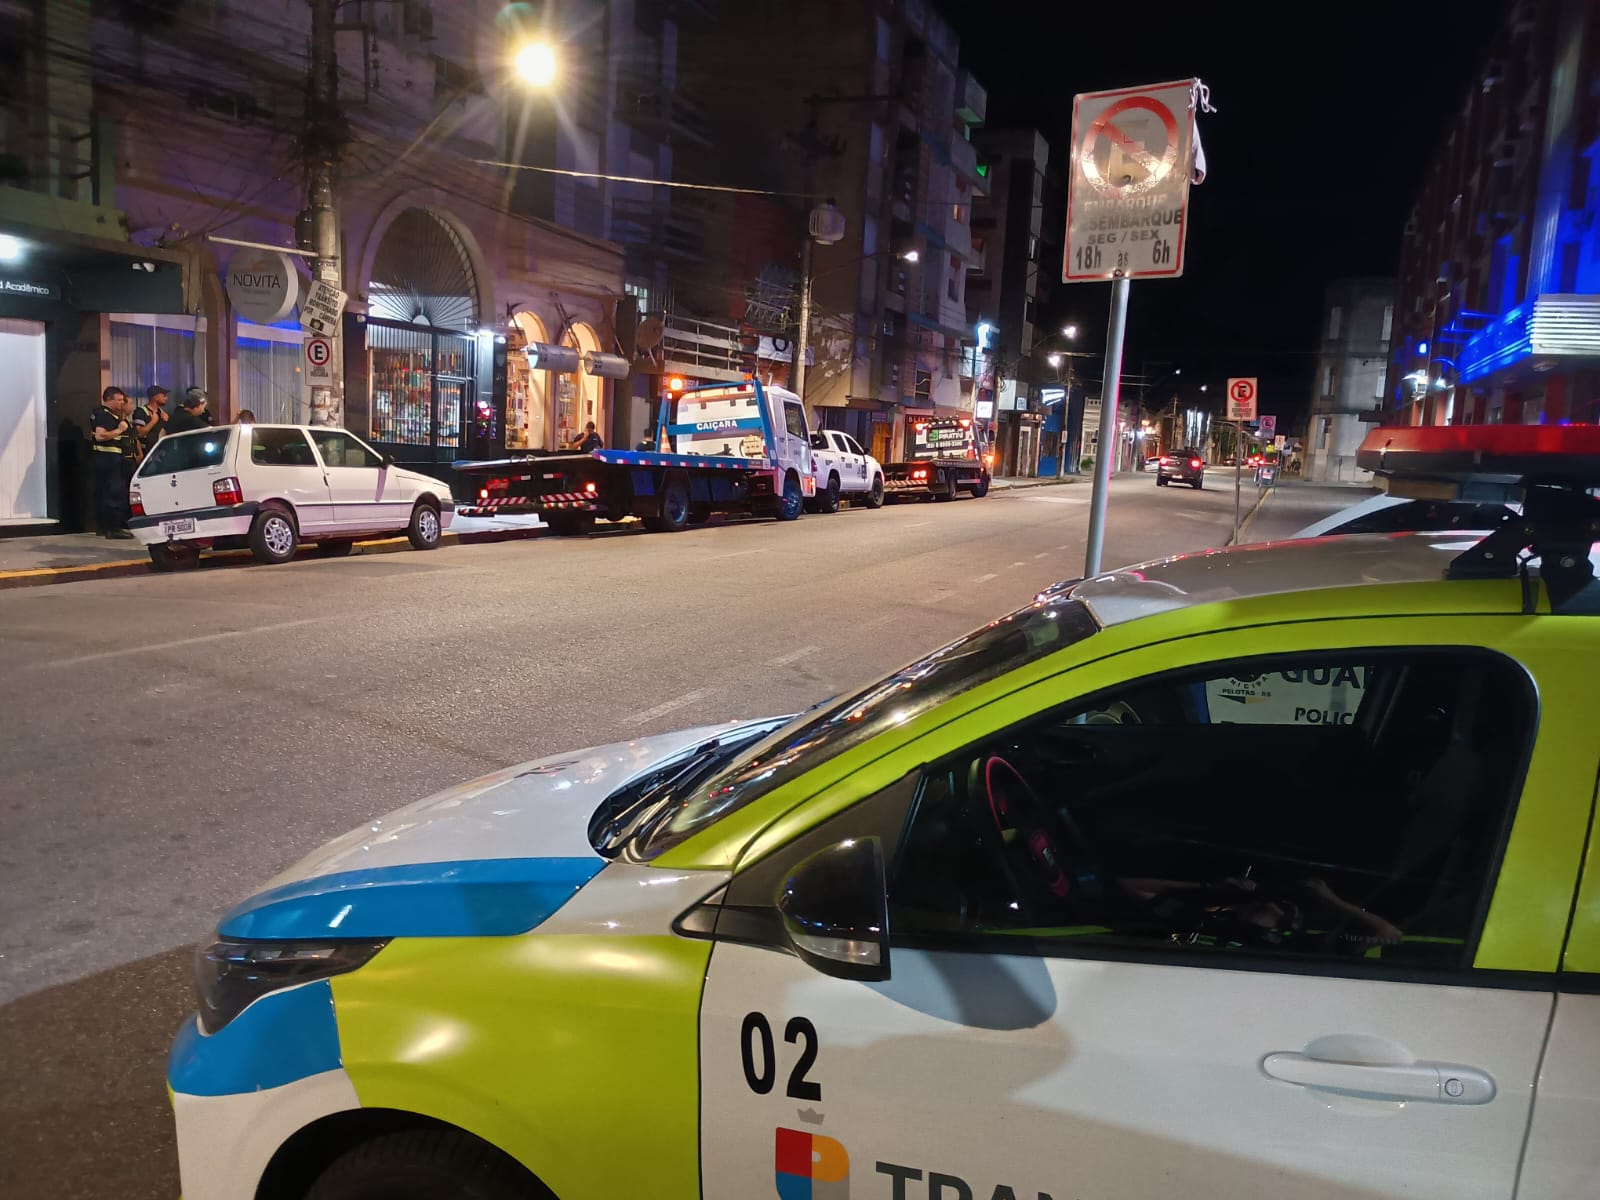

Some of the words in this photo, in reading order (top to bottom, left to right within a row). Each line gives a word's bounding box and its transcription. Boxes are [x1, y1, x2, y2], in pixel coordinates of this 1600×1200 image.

[1087, 233, 1117, 245] SEG
[1130, 229, 1160, 241] SEX
[1076, 245, 1102, 270] 18h
[1152, 240, 1170, 265] 6h
[5, 281, 50, 295] Acadêmico
[233, 273, 280, 288] NOVITA
[315, 345, 323, 361] E
[696, 420, 738, 431] CAIÇARA
[741, 1011, 822, 1101] 02
